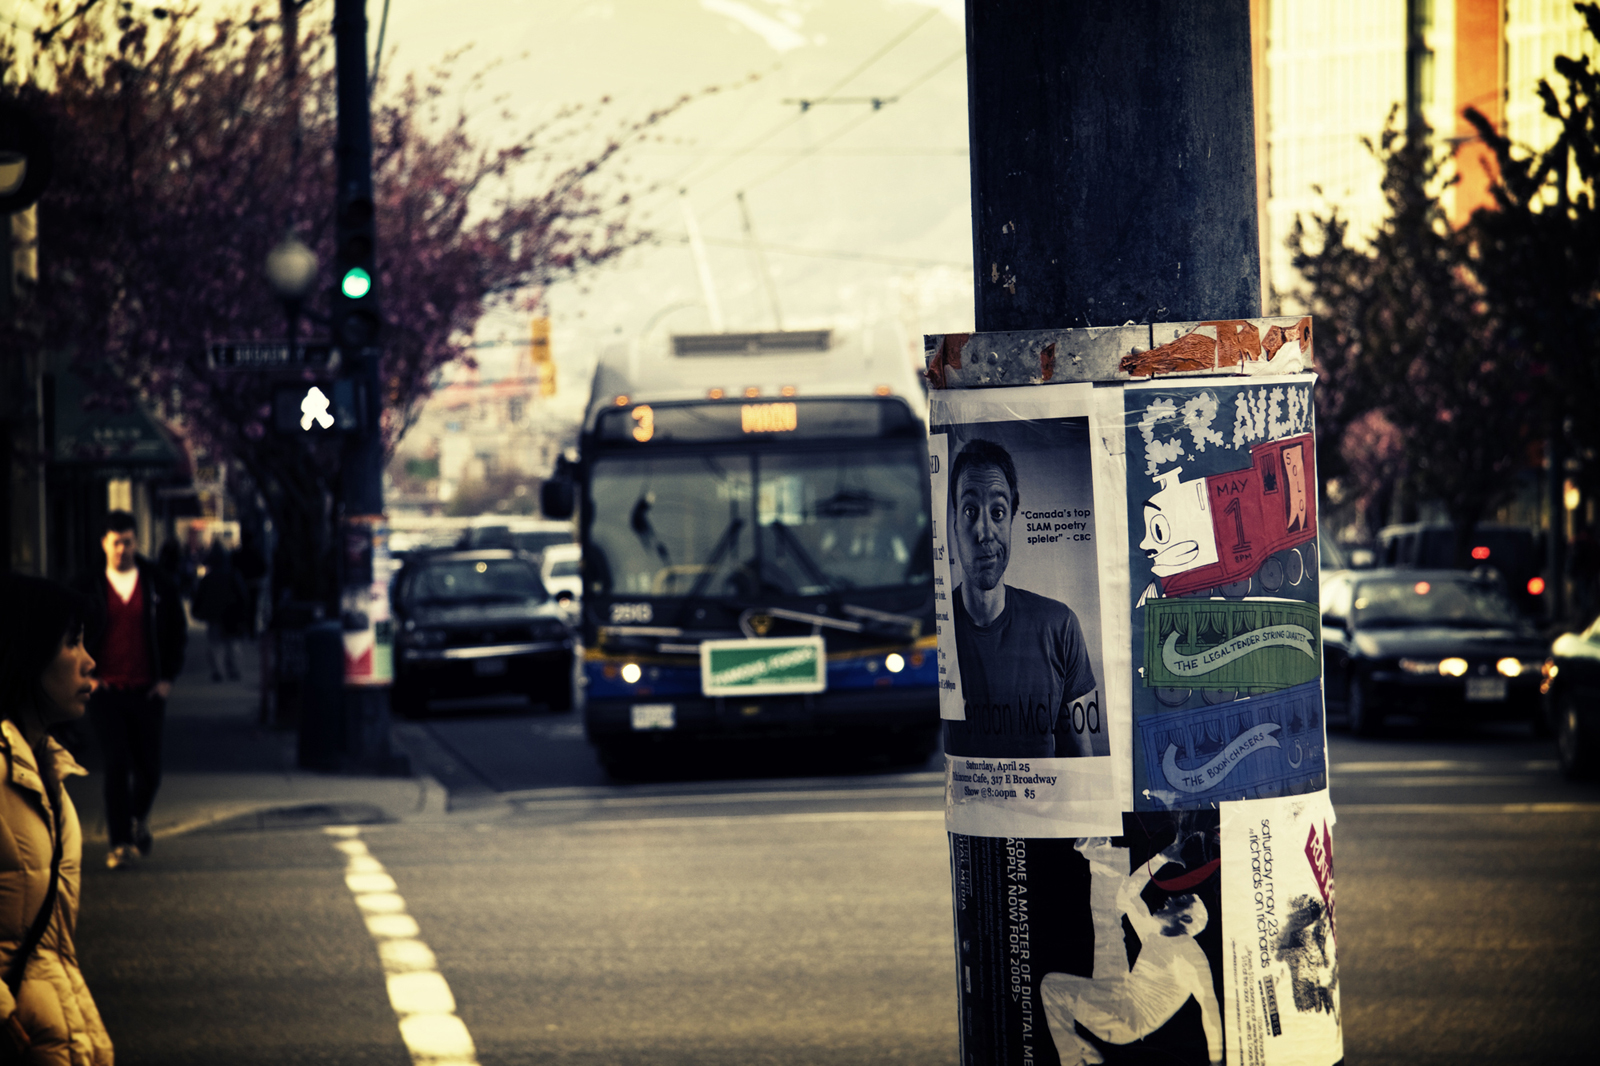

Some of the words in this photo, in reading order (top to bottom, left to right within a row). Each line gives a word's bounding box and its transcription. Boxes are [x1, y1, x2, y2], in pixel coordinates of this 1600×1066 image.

[632, 404, 654, 442] 3
[1216, 478, 1248, 498] MAY
[1285, 452, 1305, 512] SOLO
[1026, 522, 1052, 532] SLAM
[1054, 522, 1086, 533] poetry
[1074, 508, 1091, 520] top
[1224, 497, 1251, 554] 1
[1073, 534, 1091, 542] CBC
[1174, 658, 1198, 672] THE
[1202, 648, 1231, 664] LEGAL
[1232, 634, 1260, 652] TENDER
[1262, 630, 1284, 642] STRING
[1286, 630, 1306, 643] QUARTET
[1018, 690, 1101, 735] McLeod
[966, 760, 996, 772] Saturday,
[997, 760, 1017, 772] April
[1018, 762, 1030, 772] 25
[1182, 774, 1204, 788] THE
[1208, 757, 1230, 779] BOOM
[1230, 732, 1265, 761] CHASERS
[964, 786, 980, 796] Show
[1024, 788, 1036, 800] $5
[972, 774, 990, 786] Cafe,
[990, 774, 1003, 786] 317
[1005, 774, 1011, 784] E
[1012, 774, 1057, 786] Broadway
[1006, 837, 1018, 881] APPLY
[1248, 834, 1264, 889] richards
[1260, 818, 1274, 880] saturday
[1008, 884, 1018, 922] NOW
[1017, 884, 1028, 895] A
[1254, 892, 1265, 911] on
[1264, 883, 1276, 916] may
[1009, 925, 1020, 954] FOR
[1018, 898, 1031, 960] MASTER
[1256, 914, 1272, 968] richards
[1267, 918, 1279, 937] 23
[1020, 964, 1032, 983] OF
[1021, 986, 1034, 1042] DIGITAL
[1249, 985, 1258, 1014] advance
